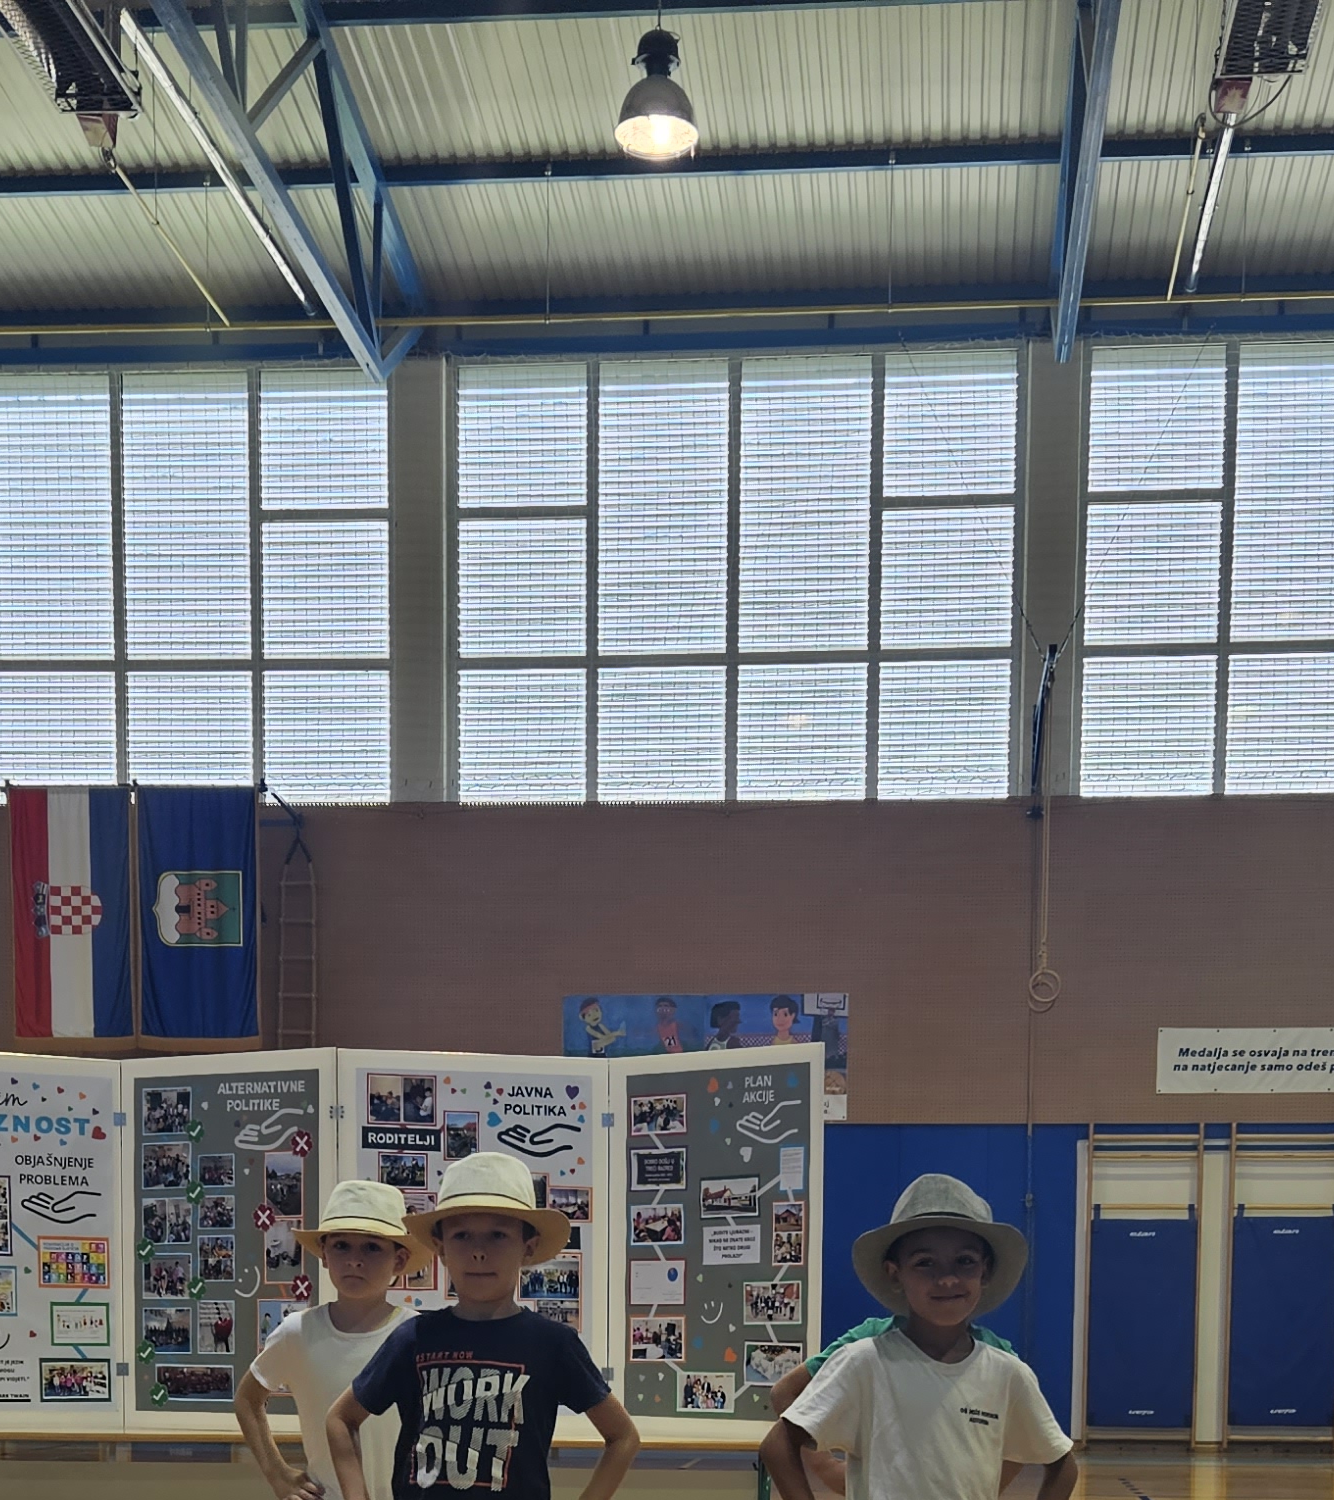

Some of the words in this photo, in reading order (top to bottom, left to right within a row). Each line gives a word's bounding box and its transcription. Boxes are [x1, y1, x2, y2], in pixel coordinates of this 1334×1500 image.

[1178, 1047, 1229, 1060] Medalja
[1232, 1049, 1246, 1058] se
[1249, 1047, 1289, 1060] osvaja
[1292, 1049, 1308, 1058] na
[1173, 1063, 1188, 1072] na
[1260, 1062, 1294, 1072] samo
[1296, 1061, 1327, 1072] odeš
[217, 1080, 305, 1094] ALTERNATIVNE
[744, 1075, 772, 1088] PLAN
[507, 1086, 554, 1098] JAVNA
[742, 1090, 775, 1105] AKCIJE
[226, 1098, 280, 1112] POLITIKE
[504, 1103, 567, 1117] POLITIKA
[368, 1131, 435, 1146] RODITELJI
[14, 1153, 95, 1170] OBJAŠNJENJE
[19, 1173, 89, 1187] PROBLEMA
[422, 1367, 530, 1424] WORK
[416, 1425, 519, 1492] OUT
